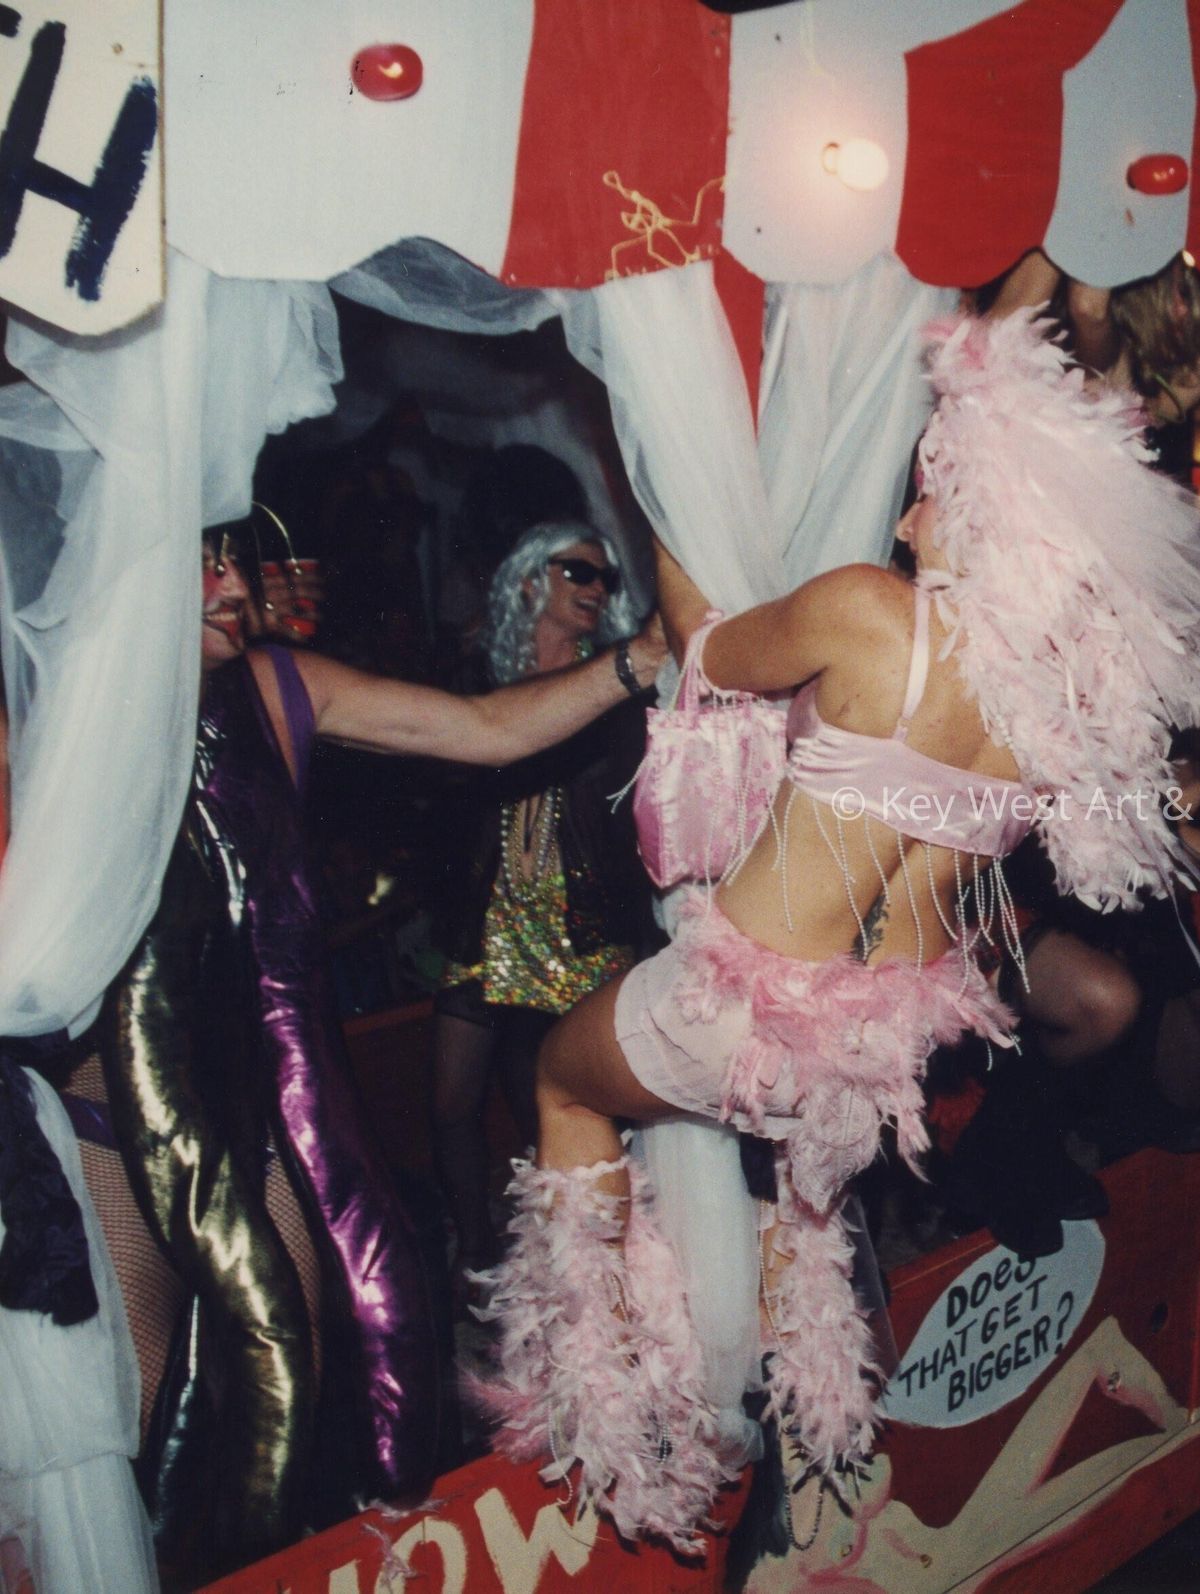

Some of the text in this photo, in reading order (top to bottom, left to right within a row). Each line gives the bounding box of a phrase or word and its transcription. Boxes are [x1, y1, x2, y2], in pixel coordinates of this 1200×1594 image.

[0, 4, 157, 302] H
[898, 1274, 1048, 1397] THAT GET
[948, 1291, 1074, 1412] BIGGER?
